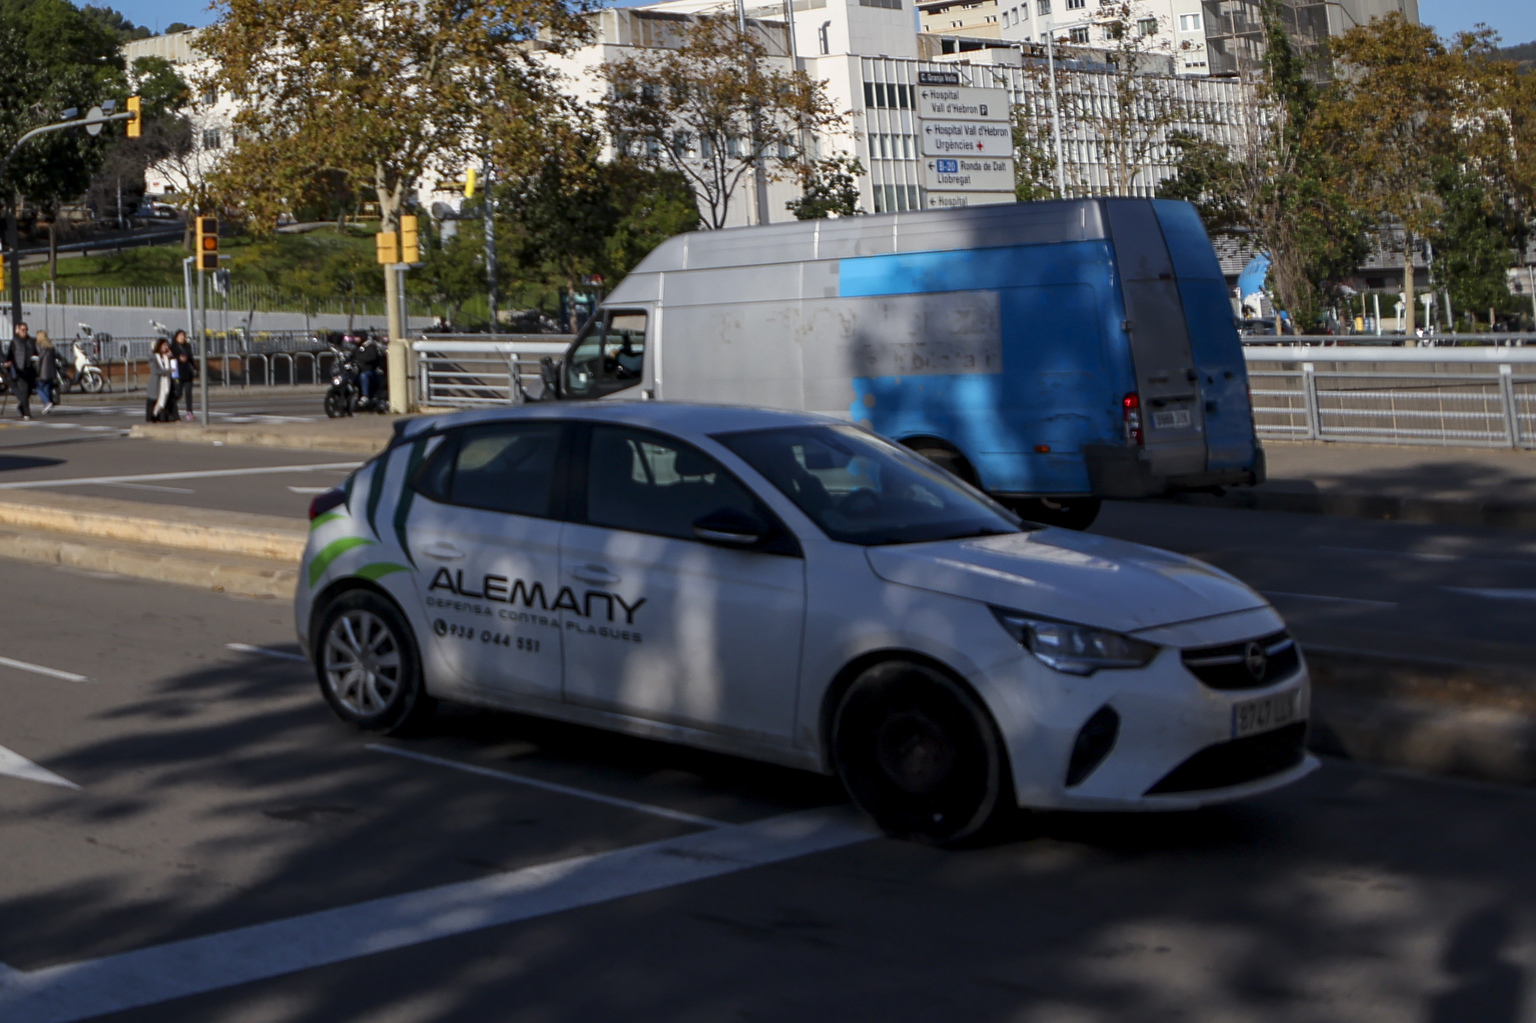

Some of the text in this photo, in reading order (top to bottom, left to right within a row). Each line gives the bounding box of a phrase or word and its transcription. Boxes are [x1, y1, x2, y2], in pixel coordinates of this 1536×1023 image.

[930, 89, 959, 101] Hospital
[932, 103, 945, 112] Vall
[946, 104, 978, 114] d'Hebron
[934, 123, 1008, 136] Hospital Vall d'Hebron
[939, 160, 1006, 172] B-20 Ronda de Dalt
[937, 174, 971, 185] Llobregat
[938, 197, 967, 206] Hospital
[428, 566, 647, 625] ALEMANY
[426, 596, 643, 643] DEFENSA CONTRA PLAGUES
[480, 630, 511, 647] 044
